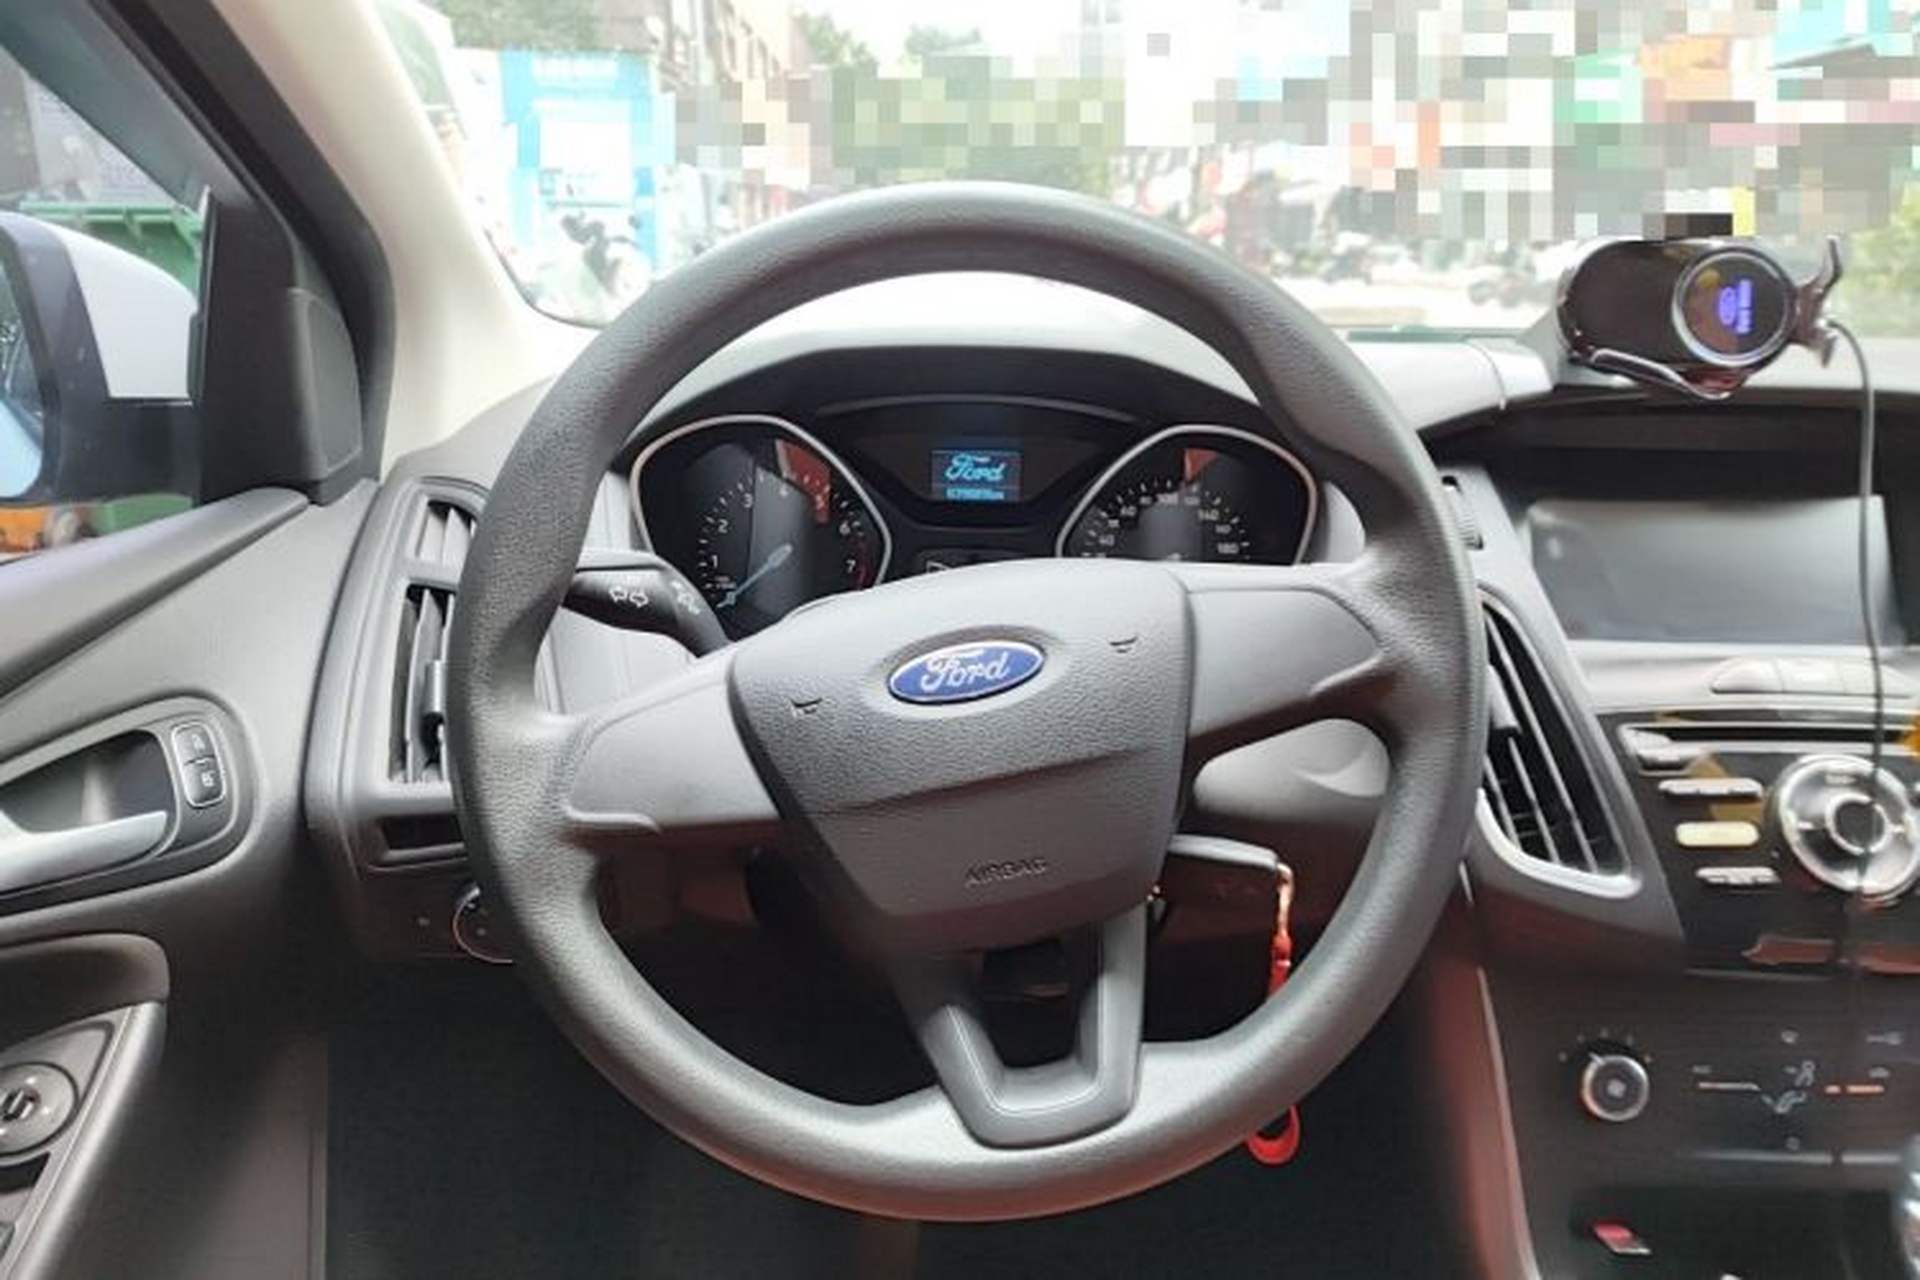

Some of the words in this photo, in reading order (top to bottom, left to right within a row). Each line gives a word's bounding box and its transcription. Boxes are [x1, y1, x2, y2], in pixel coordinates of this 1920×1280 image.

[944, 454, 1006, 480] Ford
[743, 492, 753, 508] 3
[717, 518, 728, 534] 2
[839, 521, 851, 535] 6
[711, 554, 719, 568] 1
[846, 559, 857, 573] 7
[920, 649, 1010, 693] Ford
[964, 858, 1048, 889] AIRBAG
